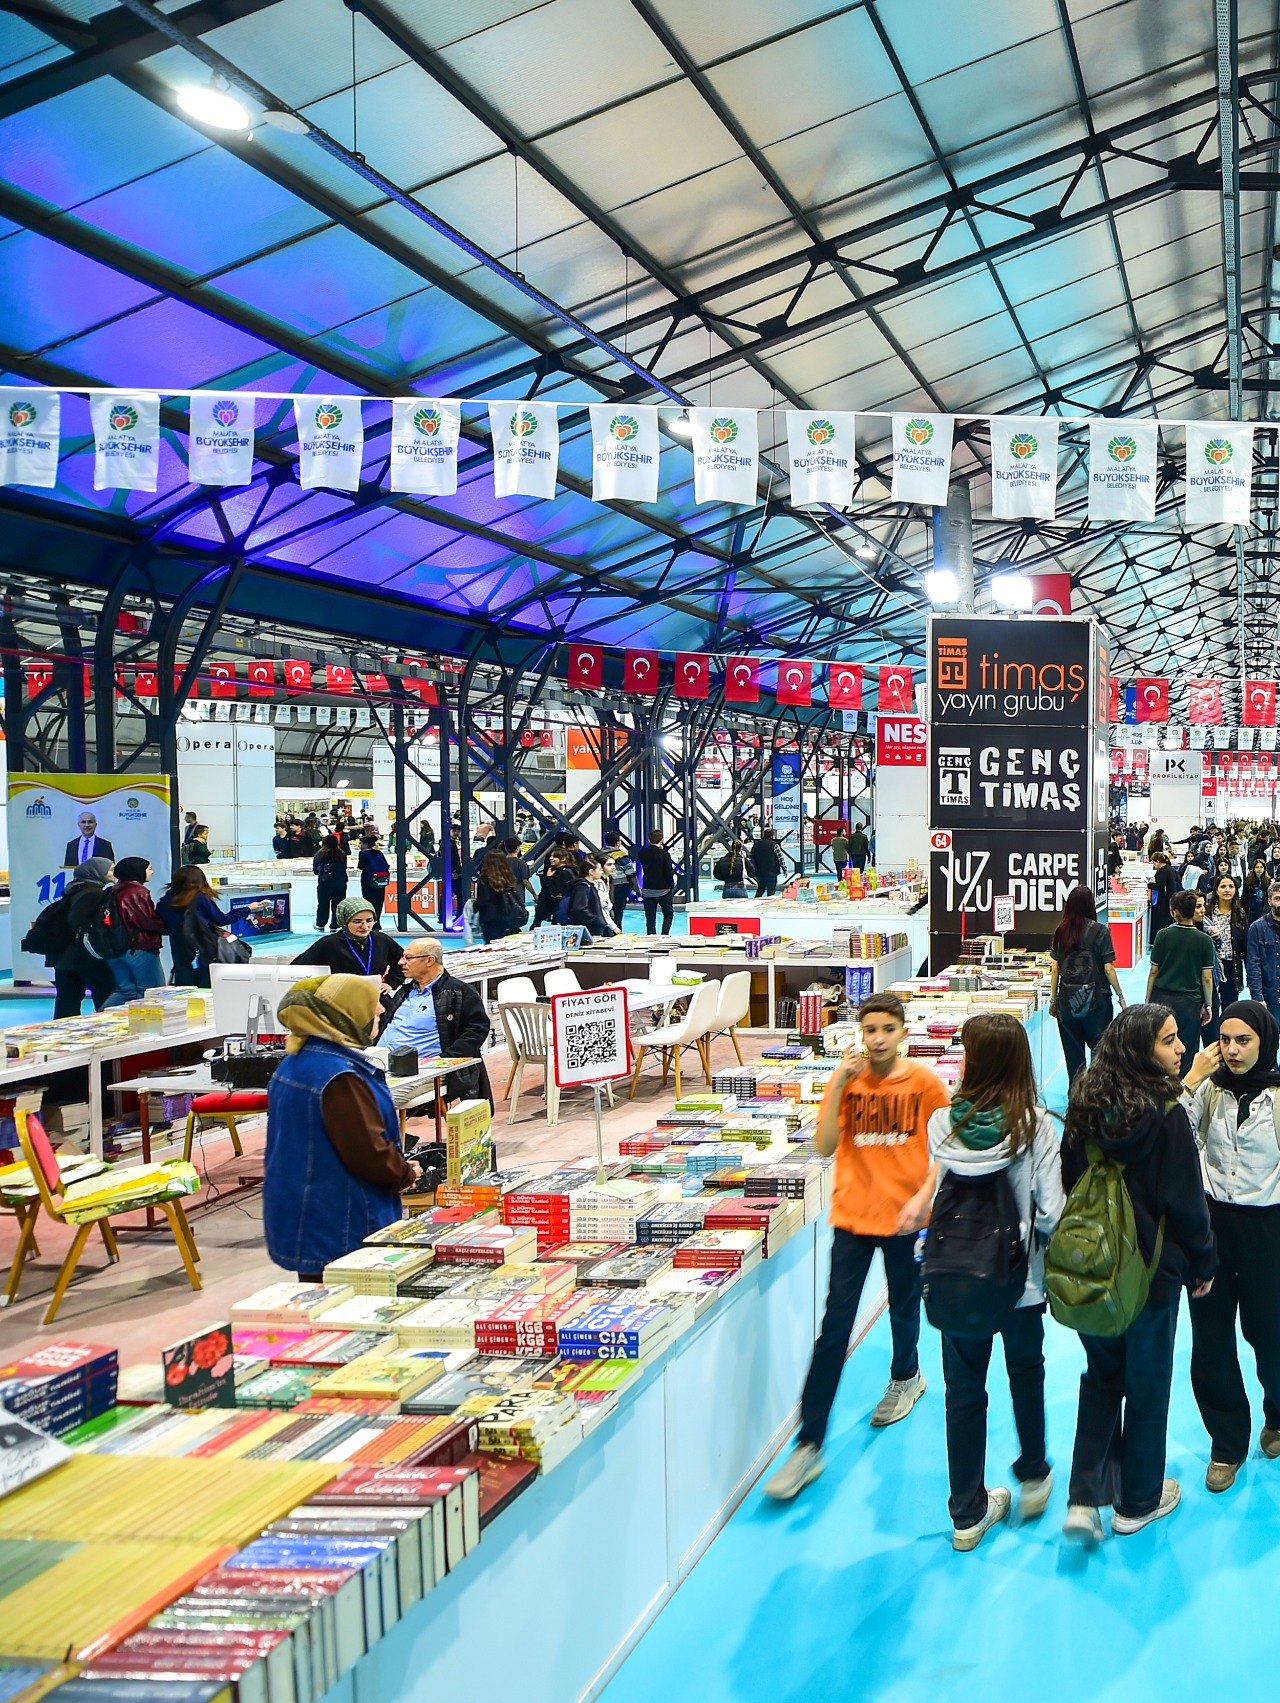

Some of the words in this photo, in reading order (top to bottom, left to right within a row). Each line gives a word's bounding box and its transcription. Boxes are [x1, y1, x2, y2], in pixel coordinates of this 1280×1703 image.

[196, 437, 249, 446] BÜYÜKŞEHİR
[303, 441, 355, 452] BÜYÜKŞEHİR
[397, 446, 452, 456] BÜYÜKŞEHİR
[794, 456, 847, 468] BÜYÜKŞEHİR
[893, 454, 944, 466] ÜYÜKŞEHİR
[996, 470, 1050, 481] BÜYÜKŞEHİR
[1094, 474, 1150, 483] BÜYÜKŞEHİR
[1191, 477, 1245, 486] BÜYÜKŞEHİR
[938, 648, 967, 658] TİMAŞ
[980, 653, 1085, 703] timaş
[938, 693, 996, 716] yayın
[1004, 686, 1064, 718] grubu
[176, 736, 231, 752] Opera
[238, 740, 274, 751] Opera
[938, 756, 971, 767] GENÇ
[979, 747, 1080, 779] GENÇ
[979, 782, 1080, 812] TİMAŞ
[936, 835, 946, 848] 64
[1009, 853, 1079, 876] CARPE
[1009, 879, 1078, 912] DİEM
[561, 996, 591, 1008] FİYAT
[593, 993, 617, 1004] GÖR
[586, 1006, 614, 1016] KİTABEVİ
[516, 1322, 543, 1333] KGB
[518, 1334, 544, 1346] KGB
[572, 1333, 592, 1341] ÇİMEN
[599, 1332, 628, 1344] CIA
[571, 1348, 592, 1356] ÇİMEN
[598, 1346, 627, 1358] CIA
